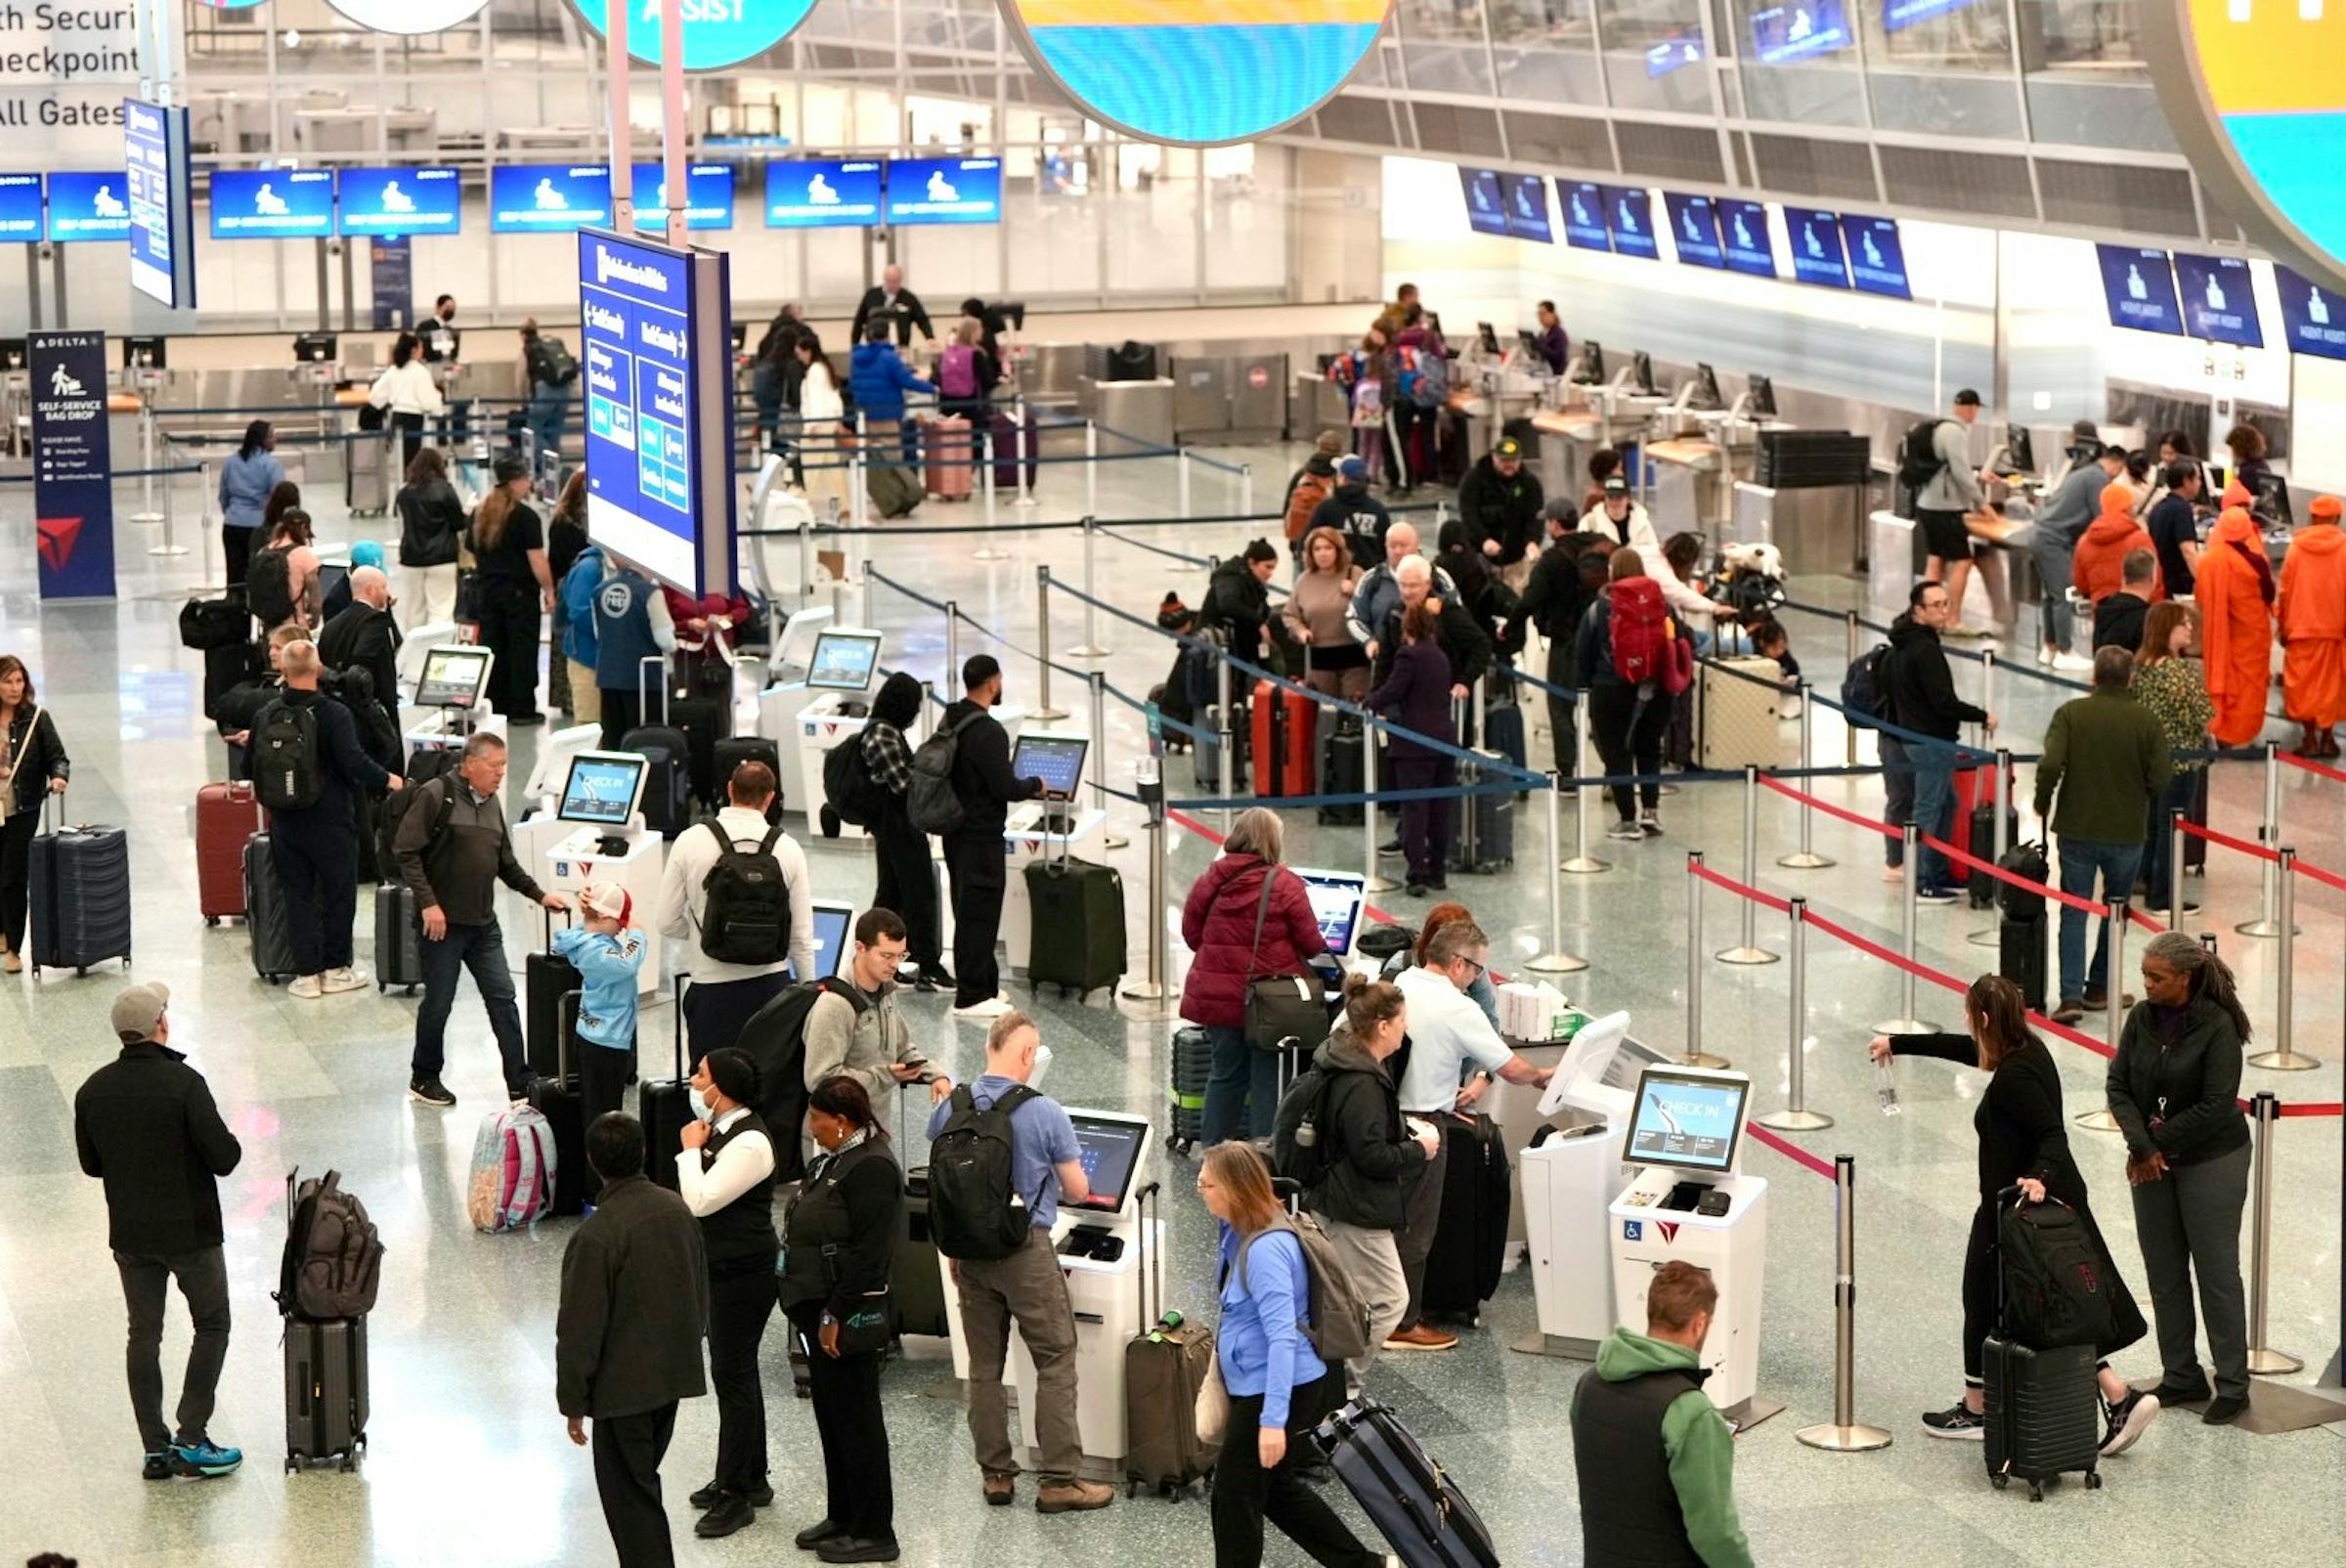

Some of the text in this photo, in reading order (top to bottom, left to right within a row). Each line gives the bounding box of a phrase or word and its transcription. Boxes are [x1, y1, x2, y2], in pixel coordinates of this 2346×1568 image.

[35, 4, 136, 30] Securi
[643, 0, 743, 21] ASIST
[0, 45, 140, 79] eckpoint
[39, 99, 126, 126] Gates
[47, 336, 88, 348] DELTA
[37, 399, 102, 412] SELF-SERVICE
[45, 411, 96, 421] BAG DROP
[284, 770, 295, 797] THULE
[1659, 1100, 1720, 1119] CHECK IN
